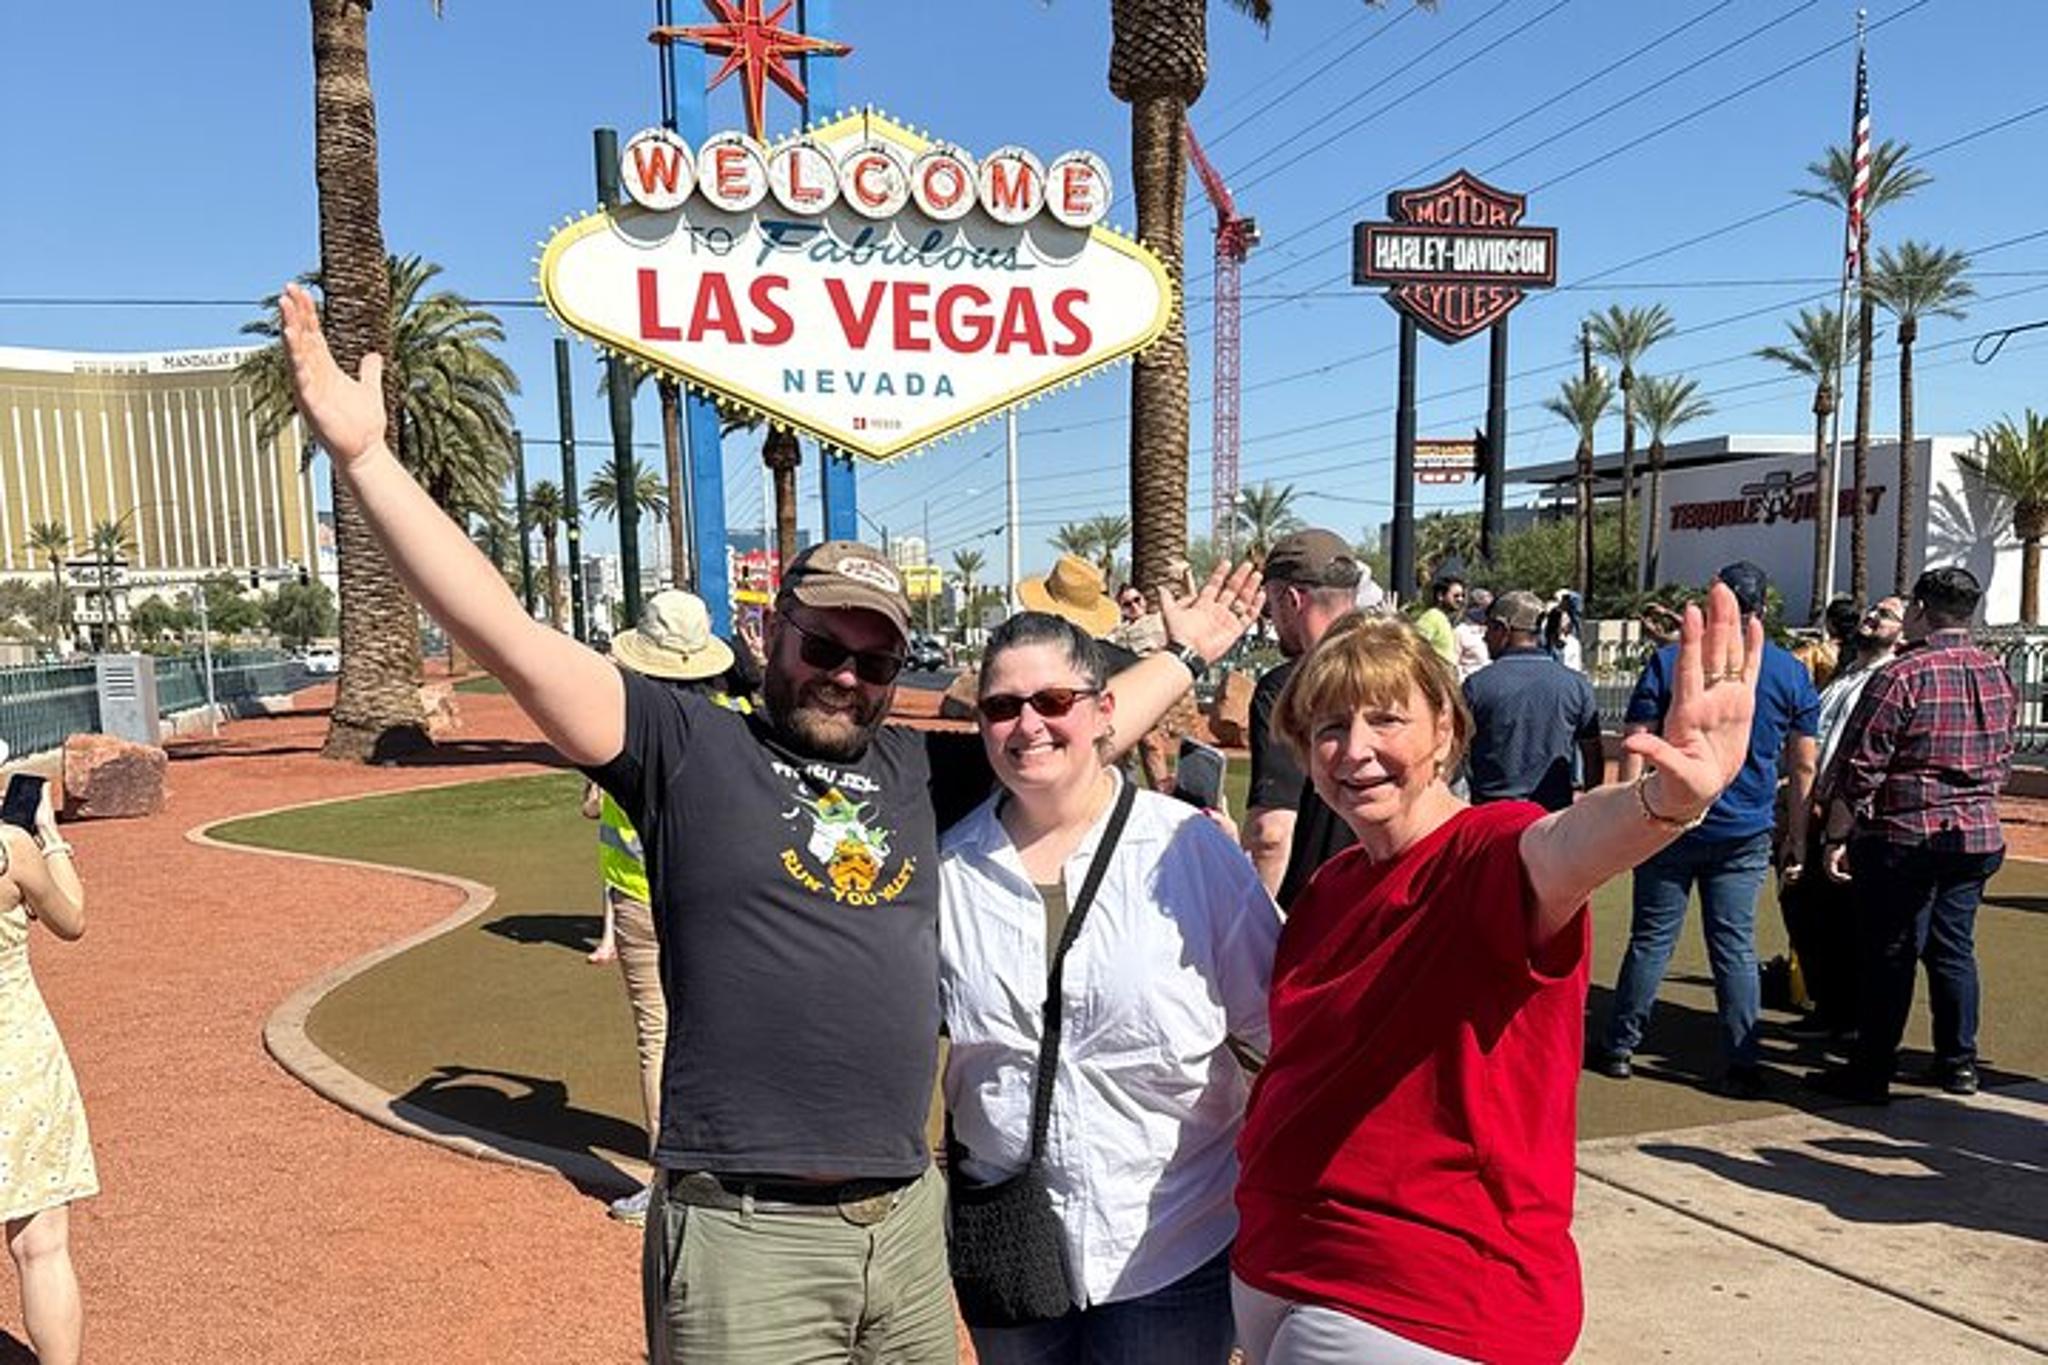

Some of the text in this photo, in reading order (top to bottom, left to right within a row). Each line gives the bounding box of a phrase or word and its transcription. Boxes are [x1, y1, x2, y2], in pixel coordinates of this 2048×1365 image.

[634, 145, 1094, 214] WELCOME
[1417, 186, 1508, 226] MOTOR
[683, 220, 1036, 271] TO Fabulous
[1375, 235, 1548, 274] HARLEY-DAVIDSON
[636, 268, 1094, 357] LAS VEGAS
[1415, 285, 1504, 326] CYCLES
[783, 368, 955, 398] NEVADA
[830, 886, 877, 906] YOU
